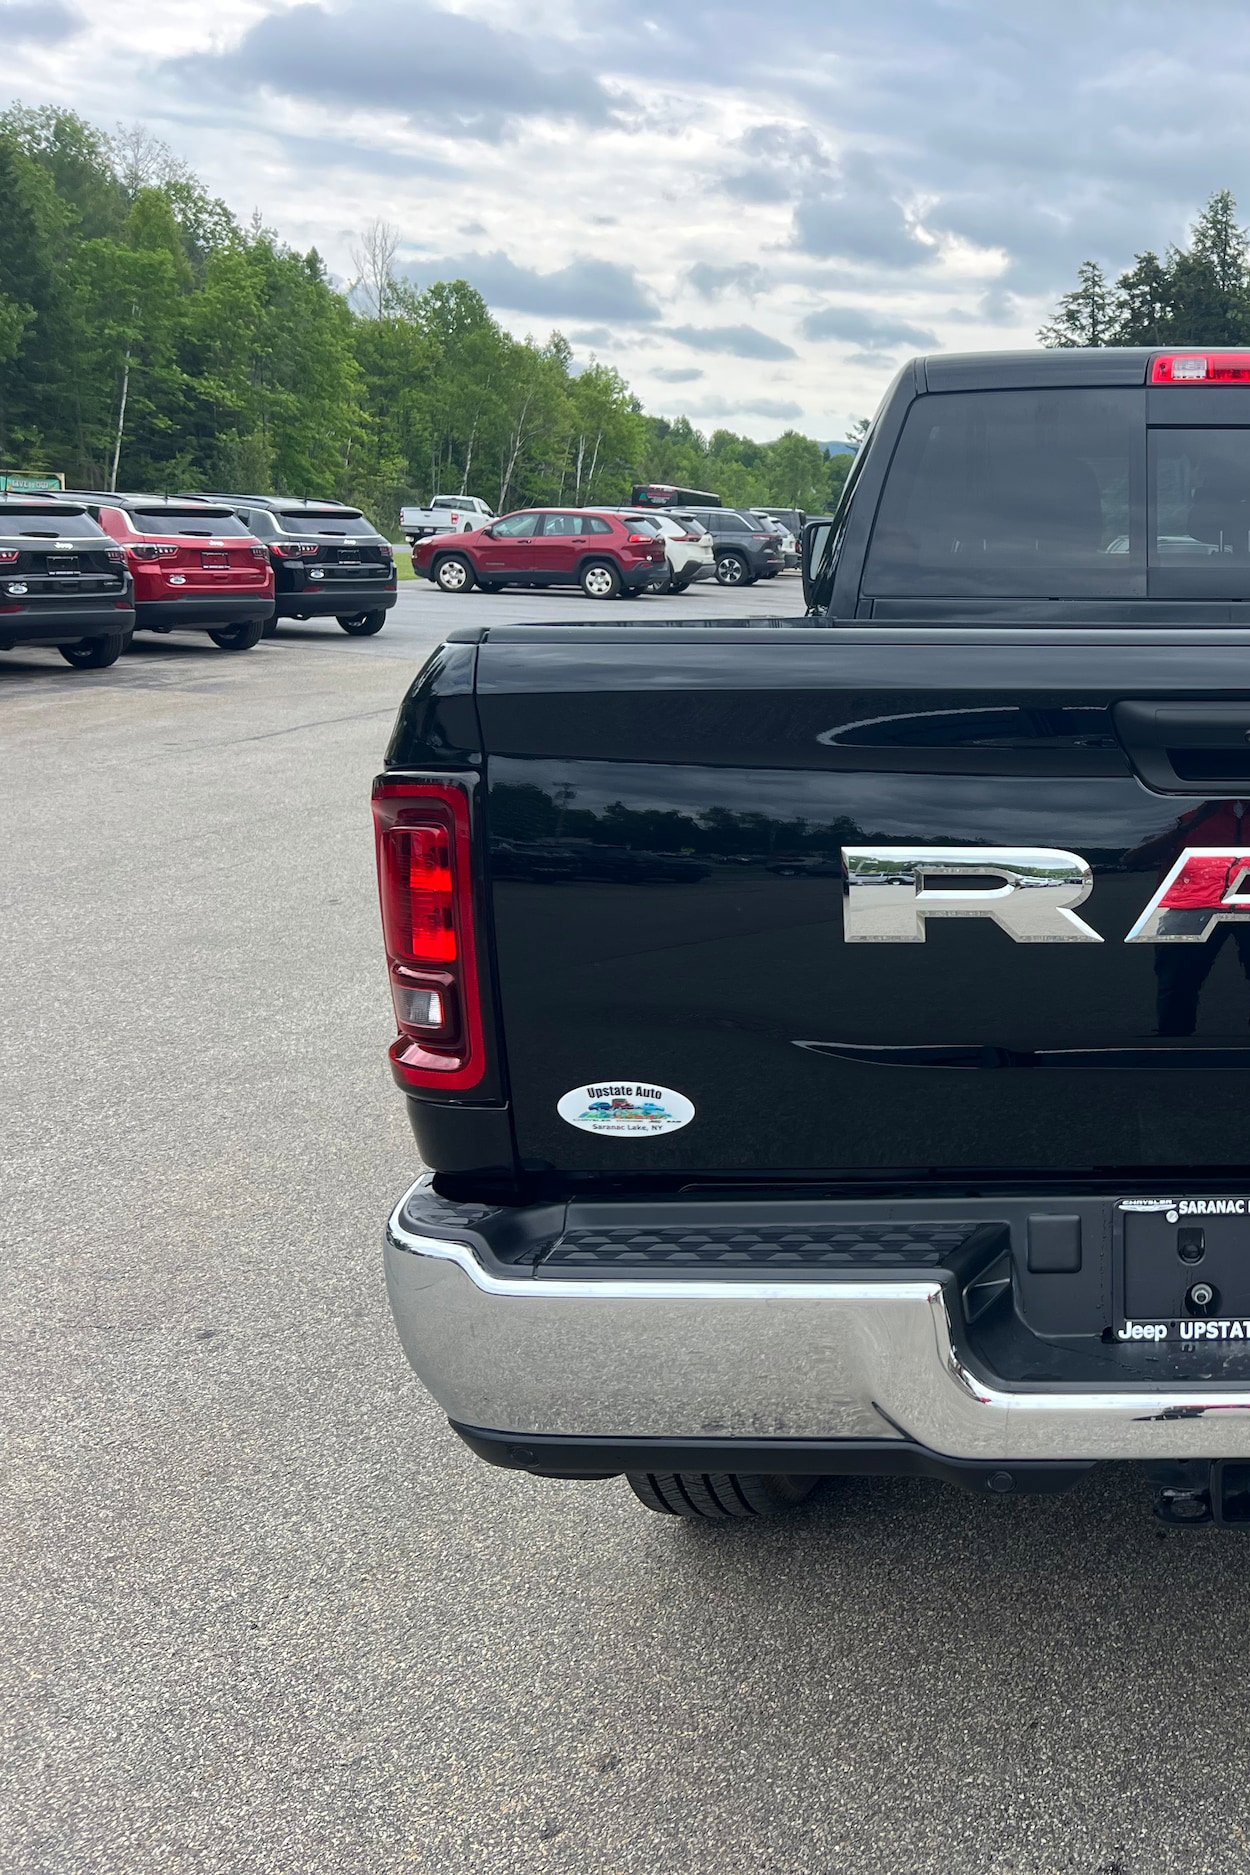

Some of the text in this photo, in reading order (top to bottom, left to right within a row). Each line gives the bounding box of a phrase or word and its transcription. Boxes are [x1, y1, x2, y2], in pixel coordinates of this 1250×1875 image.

[587, 1085, 662, 1100] Upstate Auto
[592, 1123, 625, 1131] Saranac
[627, 1124, 649, 1132] Lake,
[1179, 1200, 1245, 1214] SARANAC
[1118, 1321, 1167, 1342] Jeep
